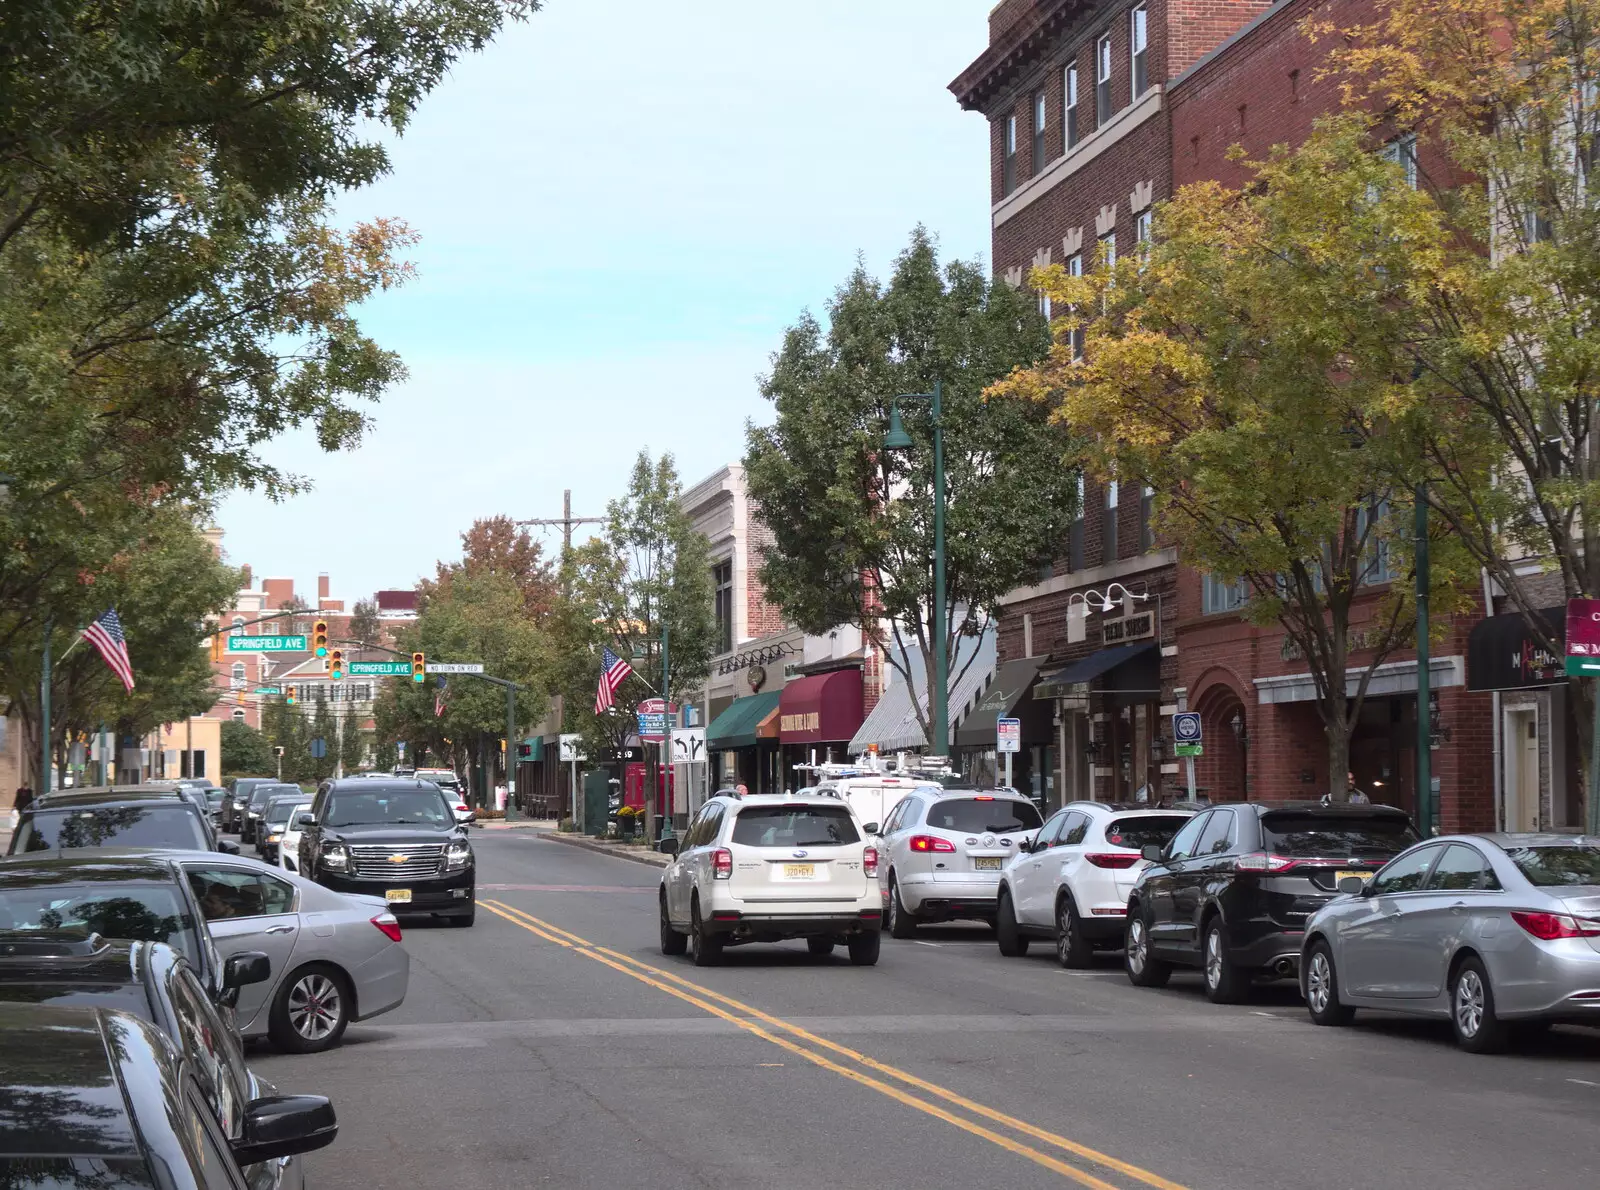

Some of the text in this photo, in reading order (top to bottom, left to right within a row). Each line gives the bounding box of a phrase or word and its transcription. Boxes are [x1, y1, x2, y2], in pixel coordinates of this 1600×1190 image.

[232, 638, 302, 649] SPRINGFIELD AVE
[352, 664, 409, 673] SPRINGFIELD AVE
